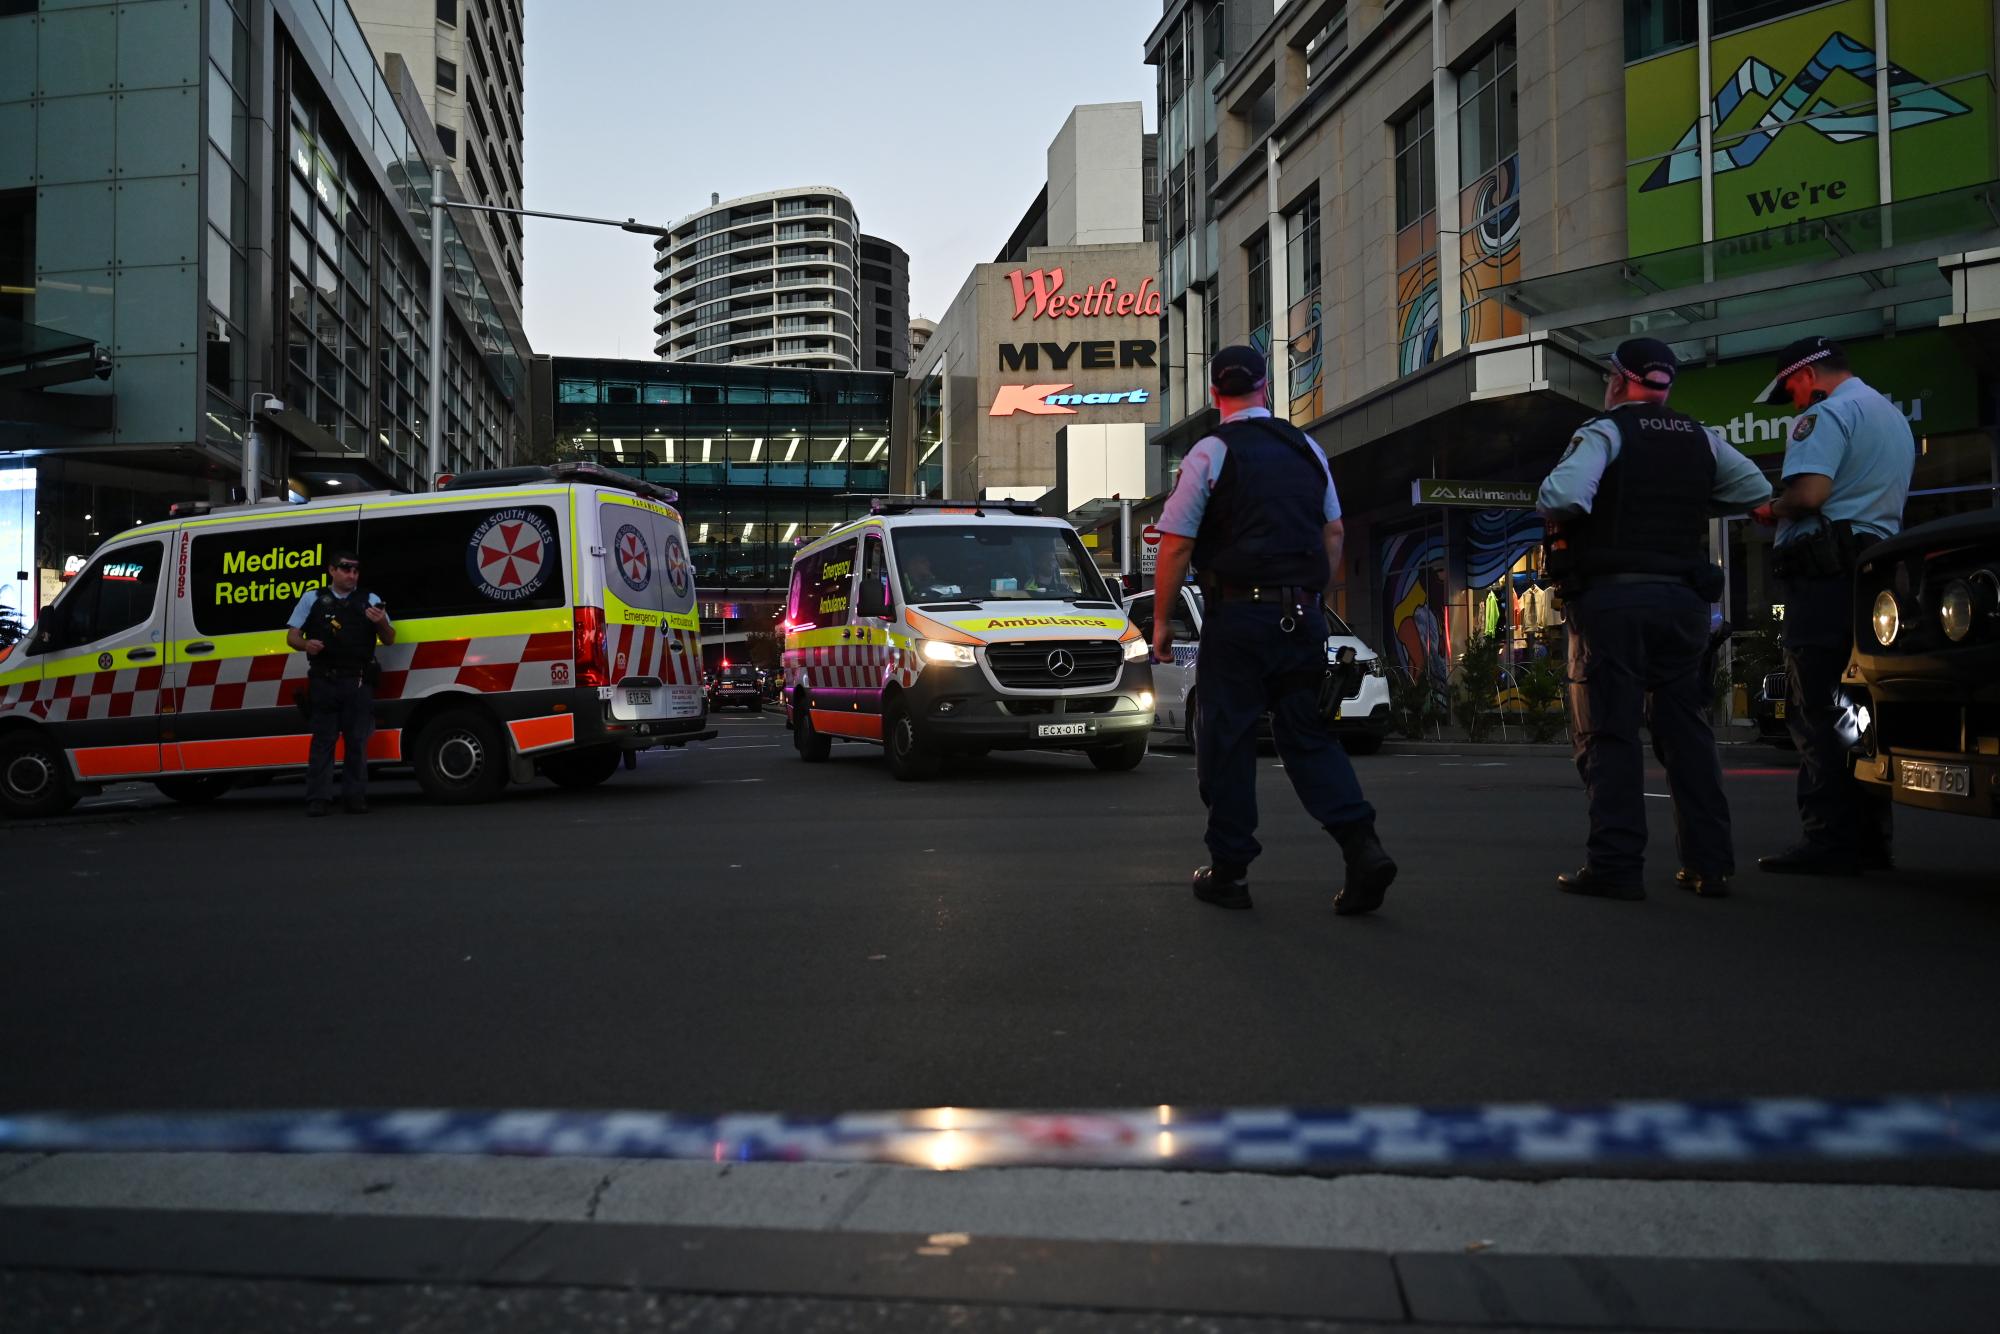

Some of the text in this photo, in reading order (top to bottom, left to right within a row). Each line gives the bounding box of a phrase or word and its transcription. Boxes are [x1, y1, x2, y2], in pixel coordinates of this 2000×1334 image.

[1746, 180, 1846, 216] We're
[998, 340, 1157, 372] MYER
[989, 384, 1149, 416] Kmart
[1639, 418, 1694, 432] POLICE
[1458, 488, 1531, 501] Kathmandu
[470, 509, 553, 547] NEW SOUTH WALES
[222, 543, 323, 575] Medical
[1147, 546, 1158, 554] NO
[822, 560, 853, 581] Emergency
[478, 577, 542, 601] AMBULANCE
[819, 594, 848, 614] Ambulance
[624, 609, 658, 625] Emergency
[988, 617, 1107, 628] Ambulance
[551, 670, 569, 680] 000
